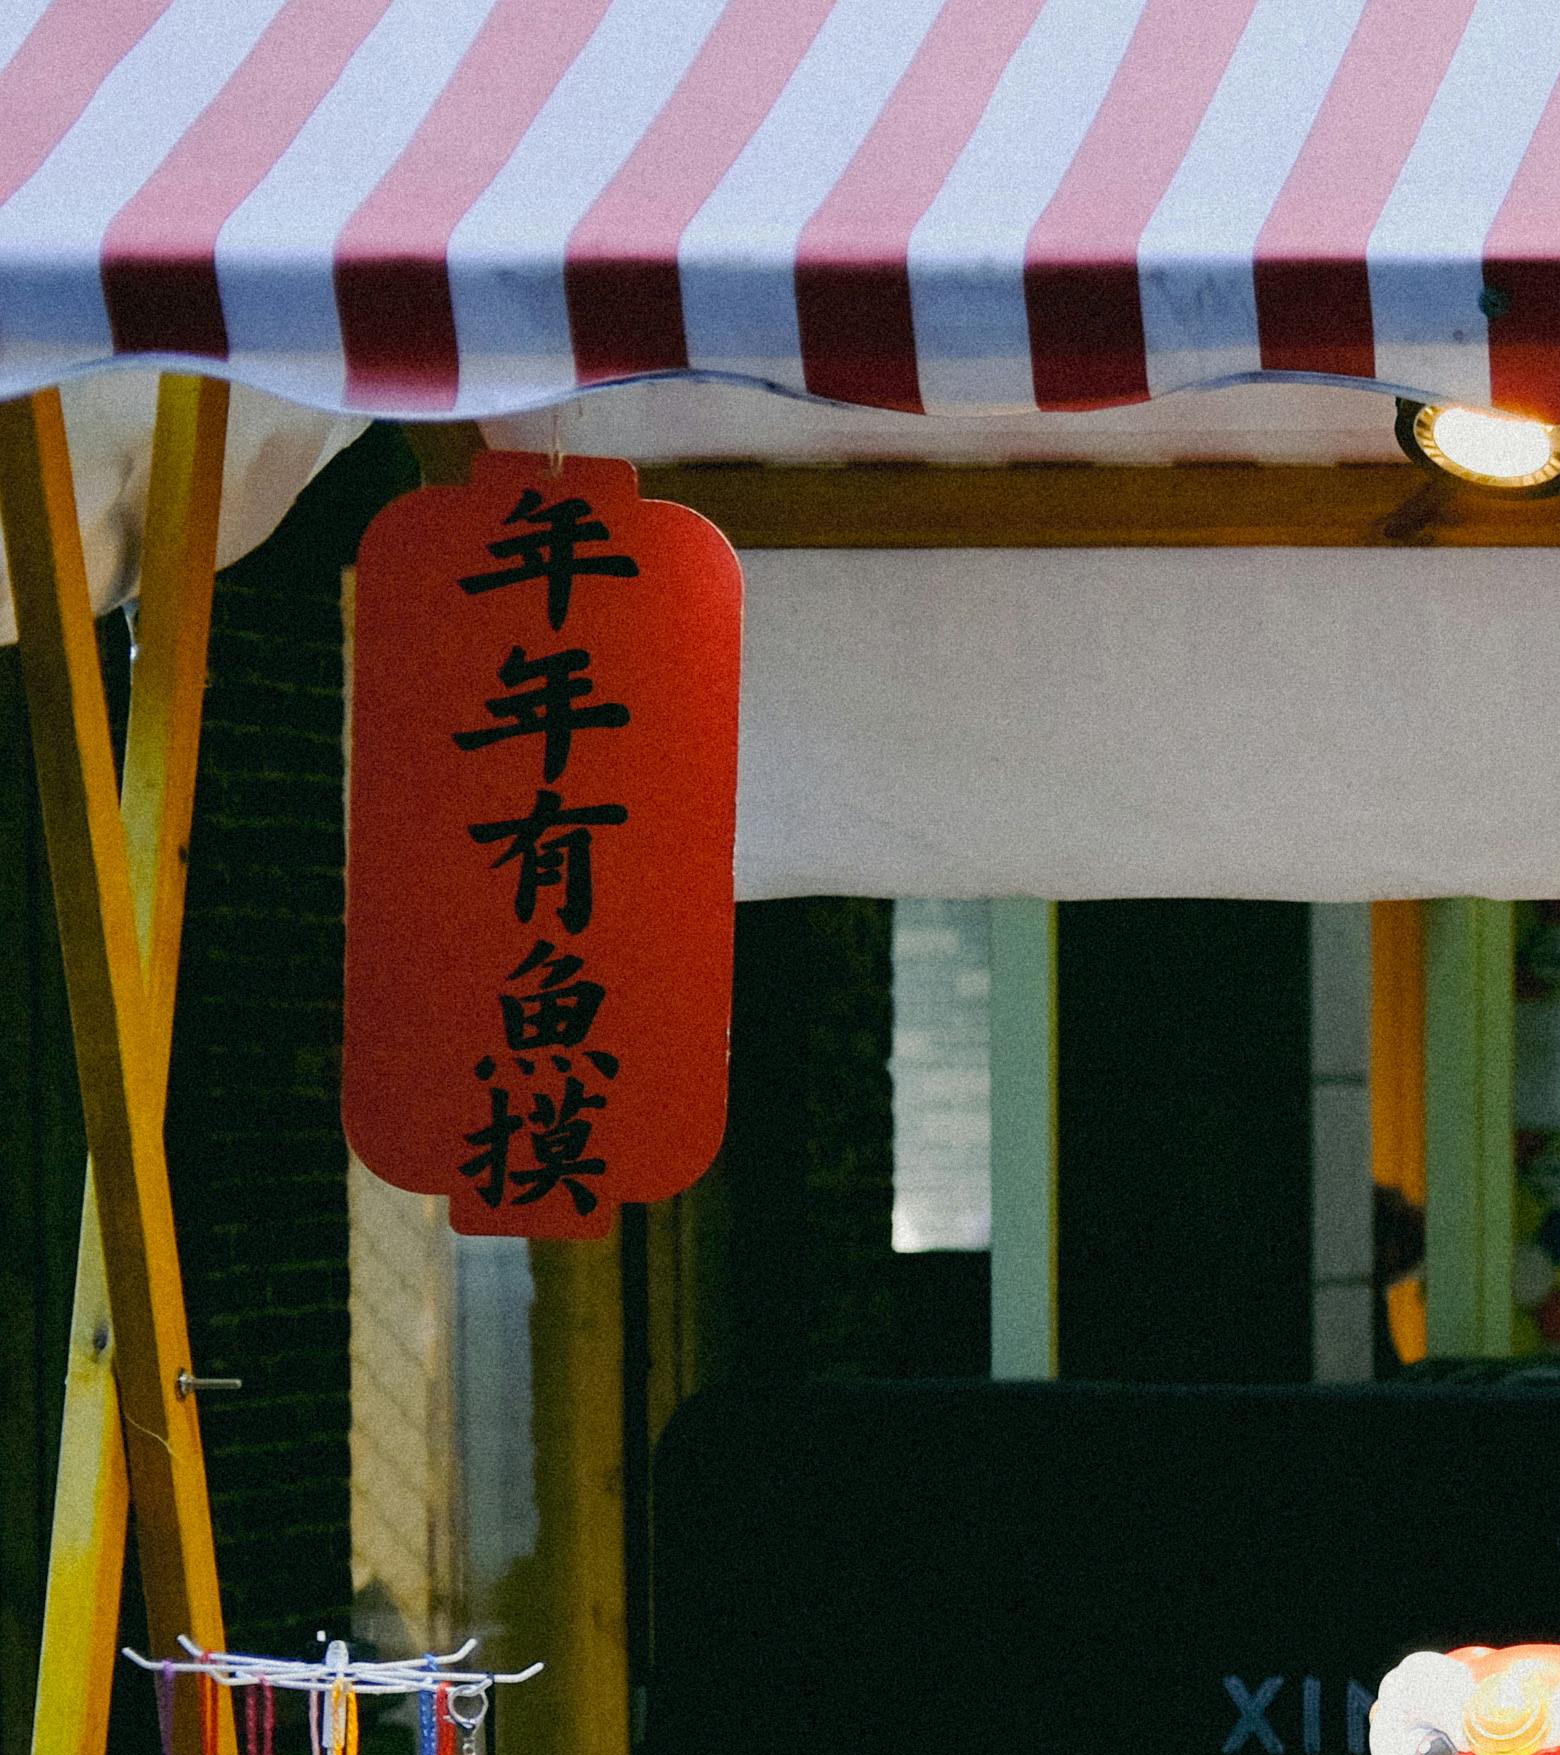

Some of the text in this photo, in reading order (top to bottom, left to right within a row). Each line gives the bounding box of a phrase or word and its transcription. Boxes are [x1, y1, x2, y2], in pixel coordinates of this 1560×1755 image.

[455, 488, 639, 1216] 年年有魚摸
